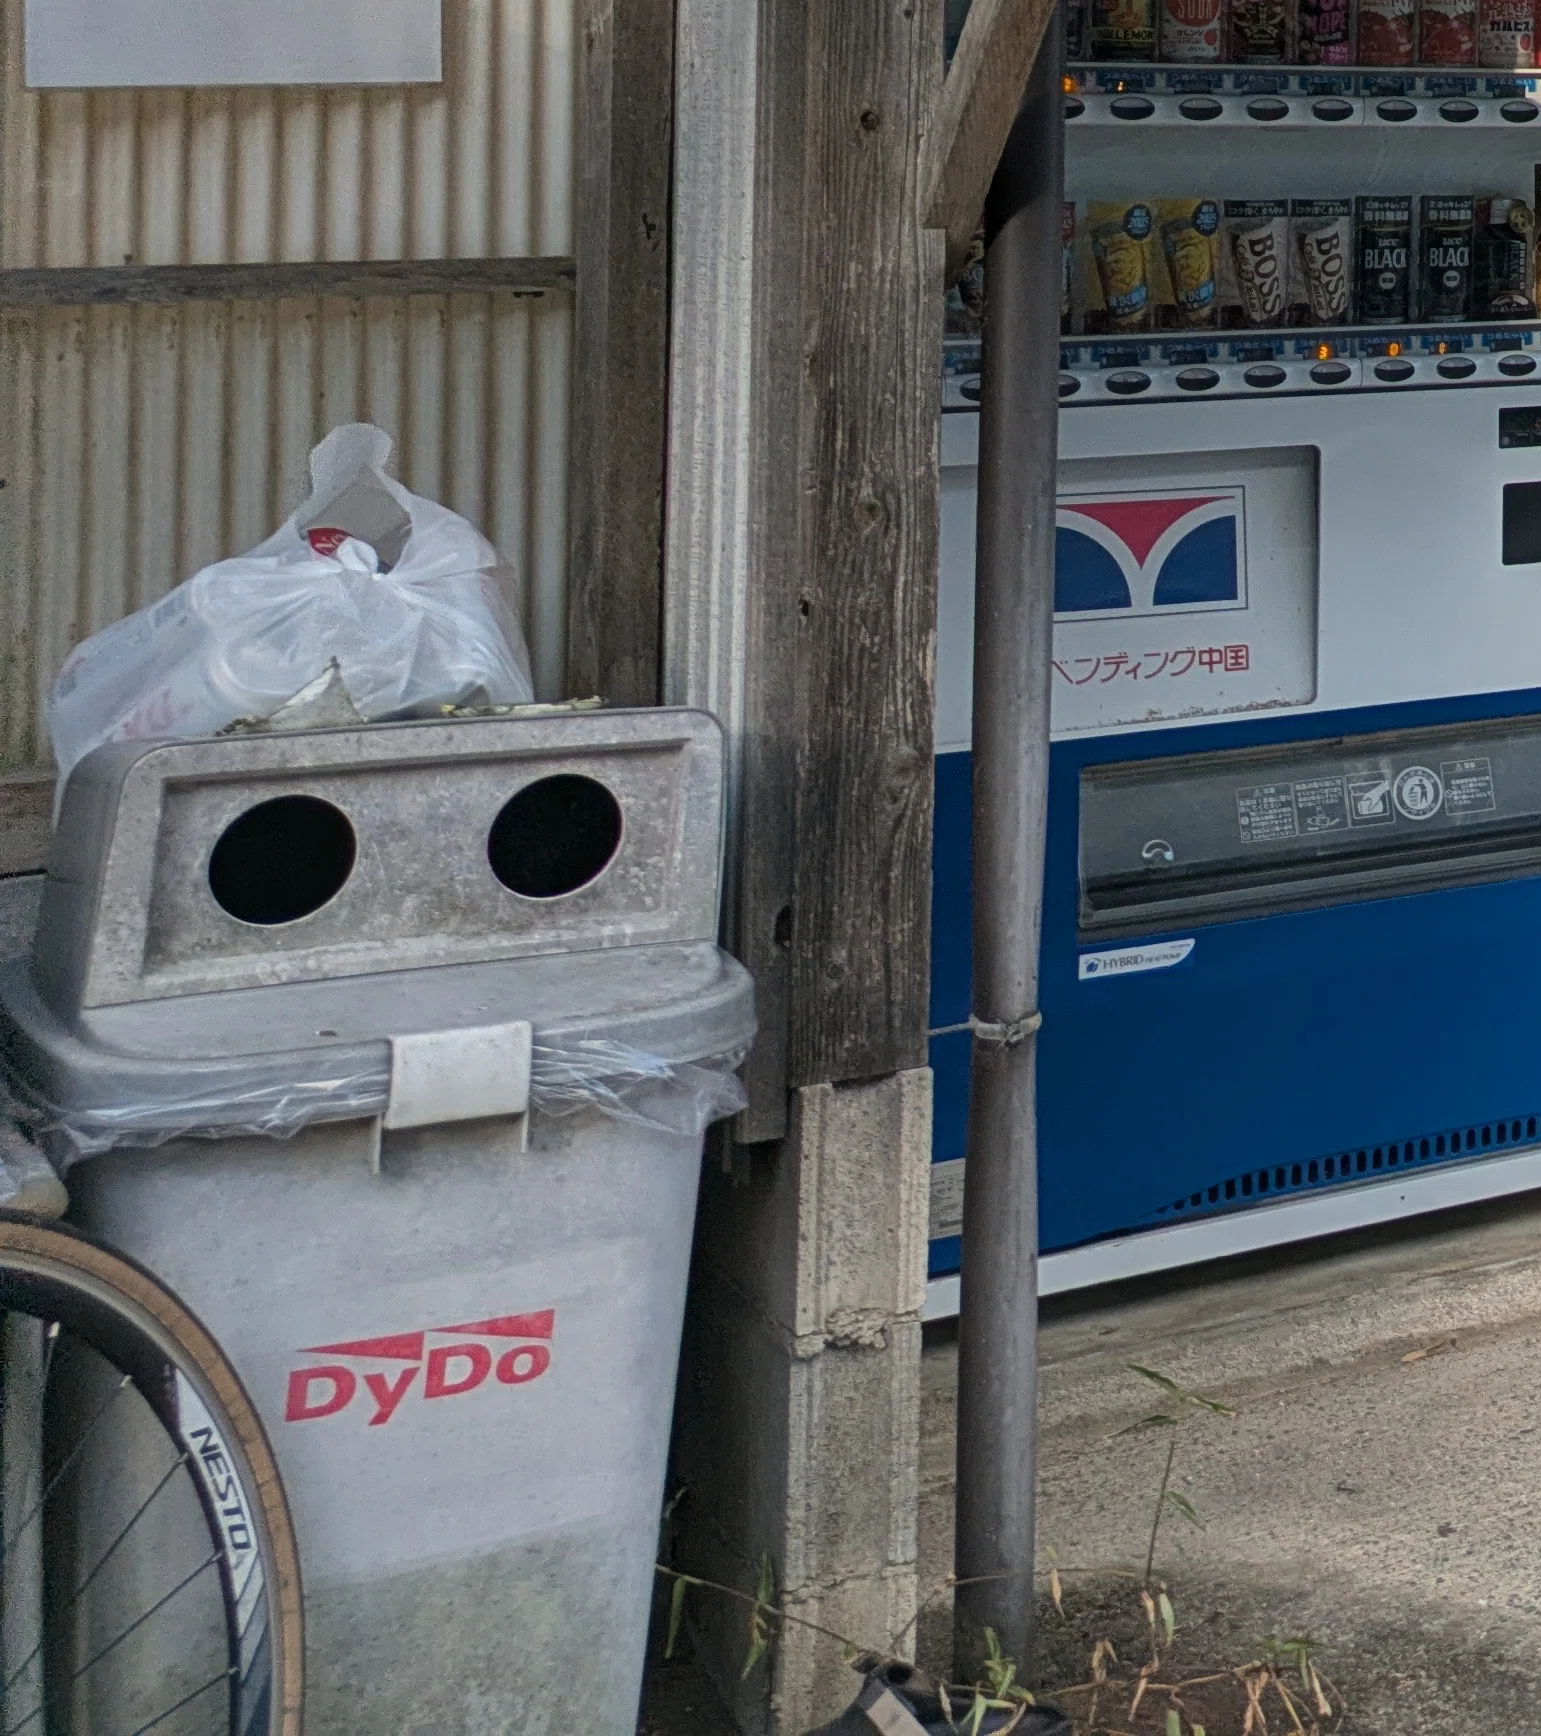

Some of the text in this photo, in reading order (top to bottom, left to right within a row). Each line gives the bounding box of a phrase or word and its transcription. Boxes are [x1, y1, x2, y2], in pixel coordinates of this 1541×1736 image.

[1249, 231, 1282, 316] BOSS
[1314, 229, 1347, 315] BOSS
[1051, 643, 1250, 685] ベンディング中国
[1102, 953, 1144, 970] HYBRID
[283, 1341, 552, 1428] DyDo
[189, 1424, 253, 1551] NESTO
